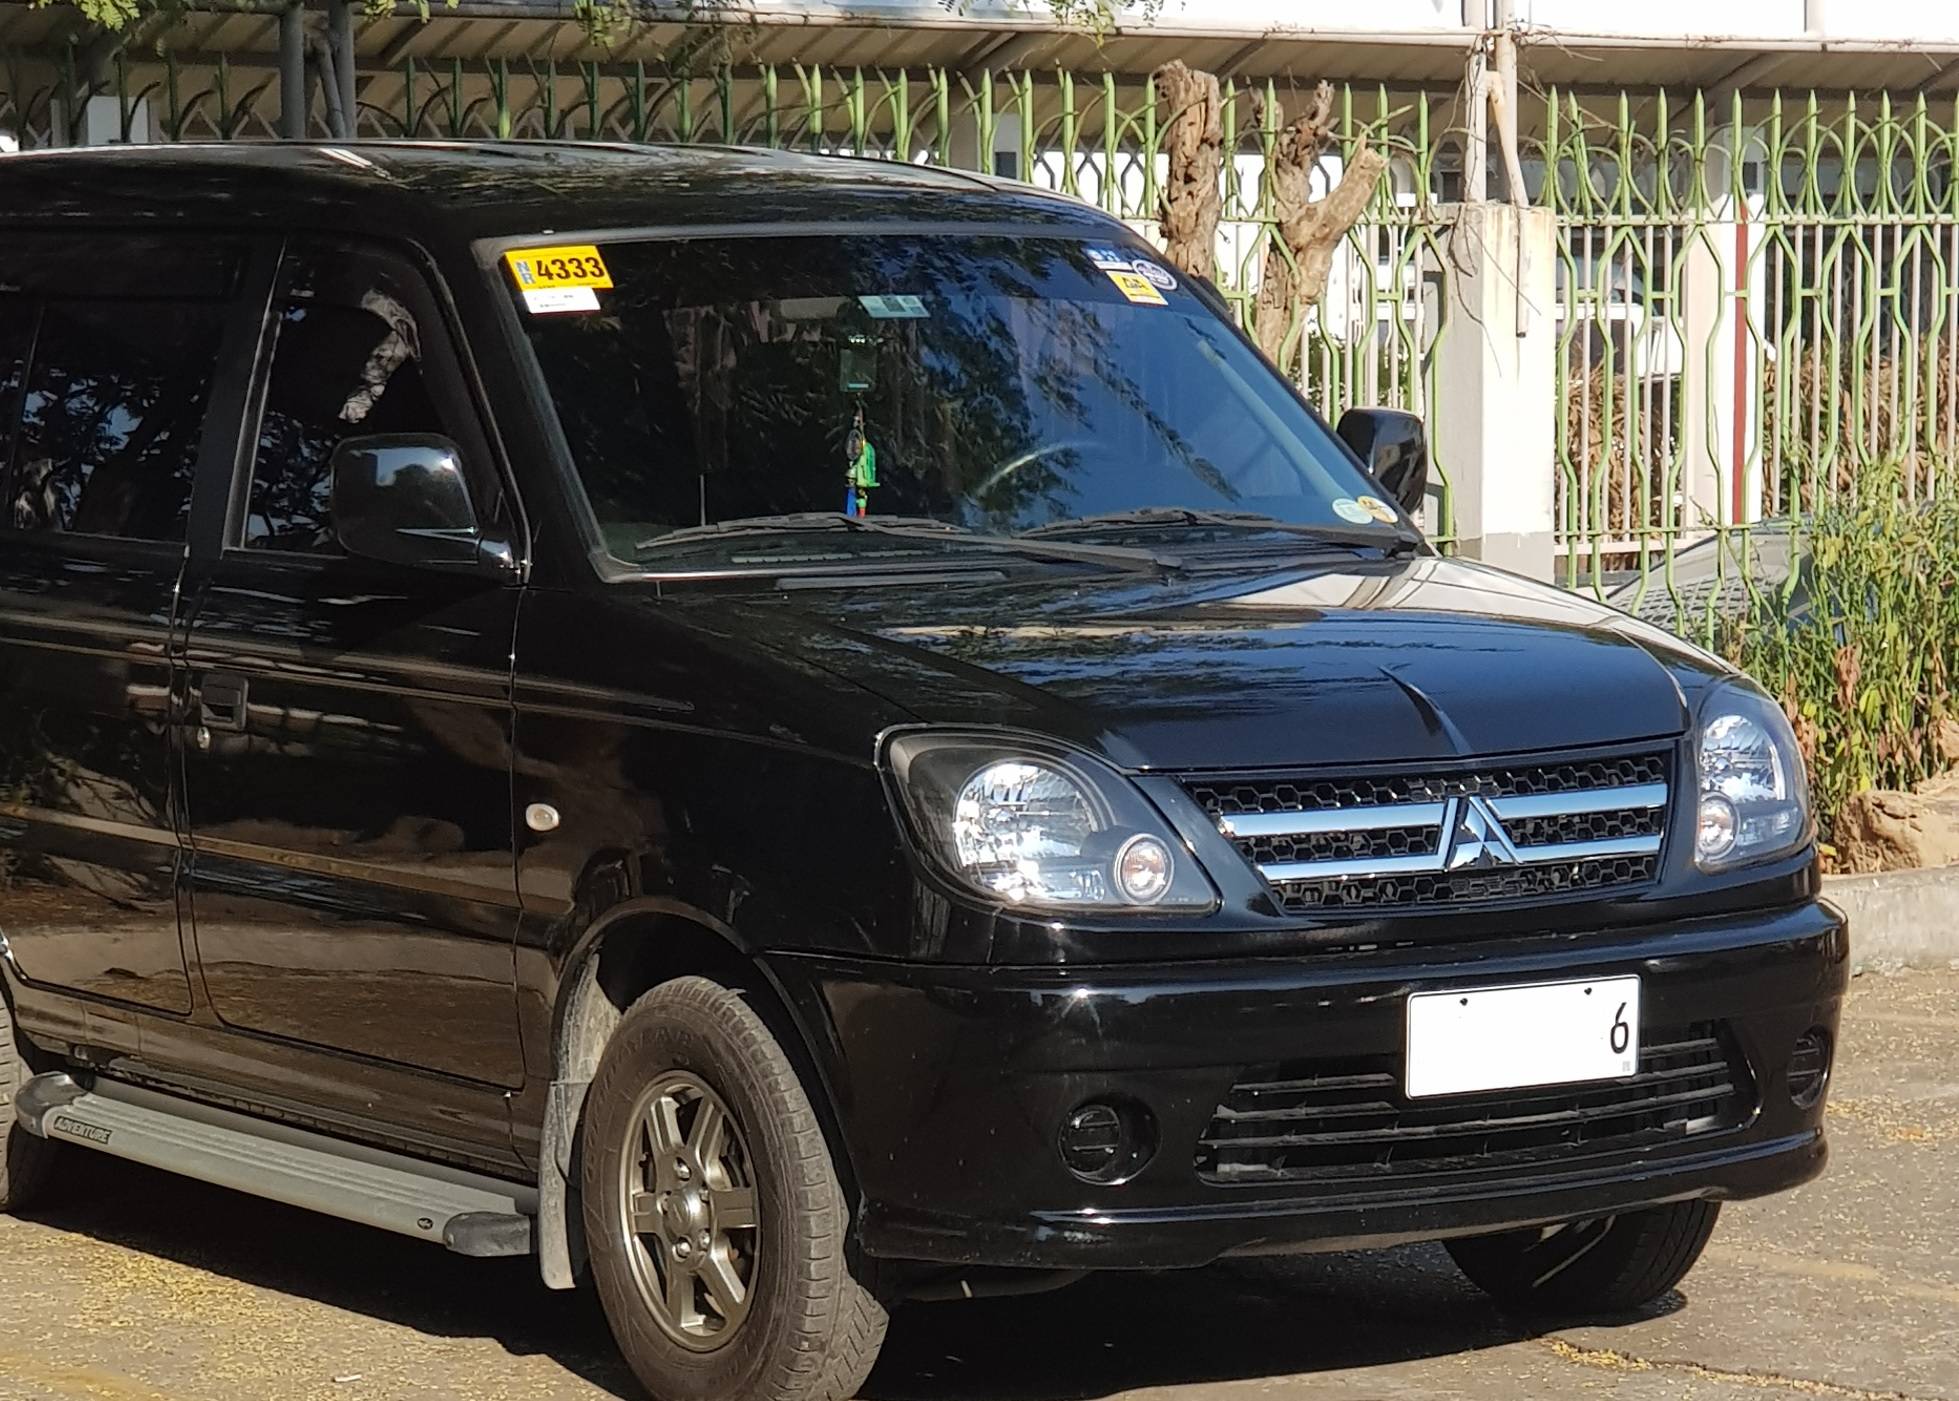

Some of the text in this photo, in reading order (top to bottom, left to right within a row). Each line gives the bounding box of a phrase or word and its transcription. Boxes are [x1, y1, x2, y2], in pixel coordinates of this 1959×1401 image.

[536, 256, 606, 281] 4333
[1610, 1002, 1629, 1054] 6
[55, 1117, 111, 1143] ADVENTURE
